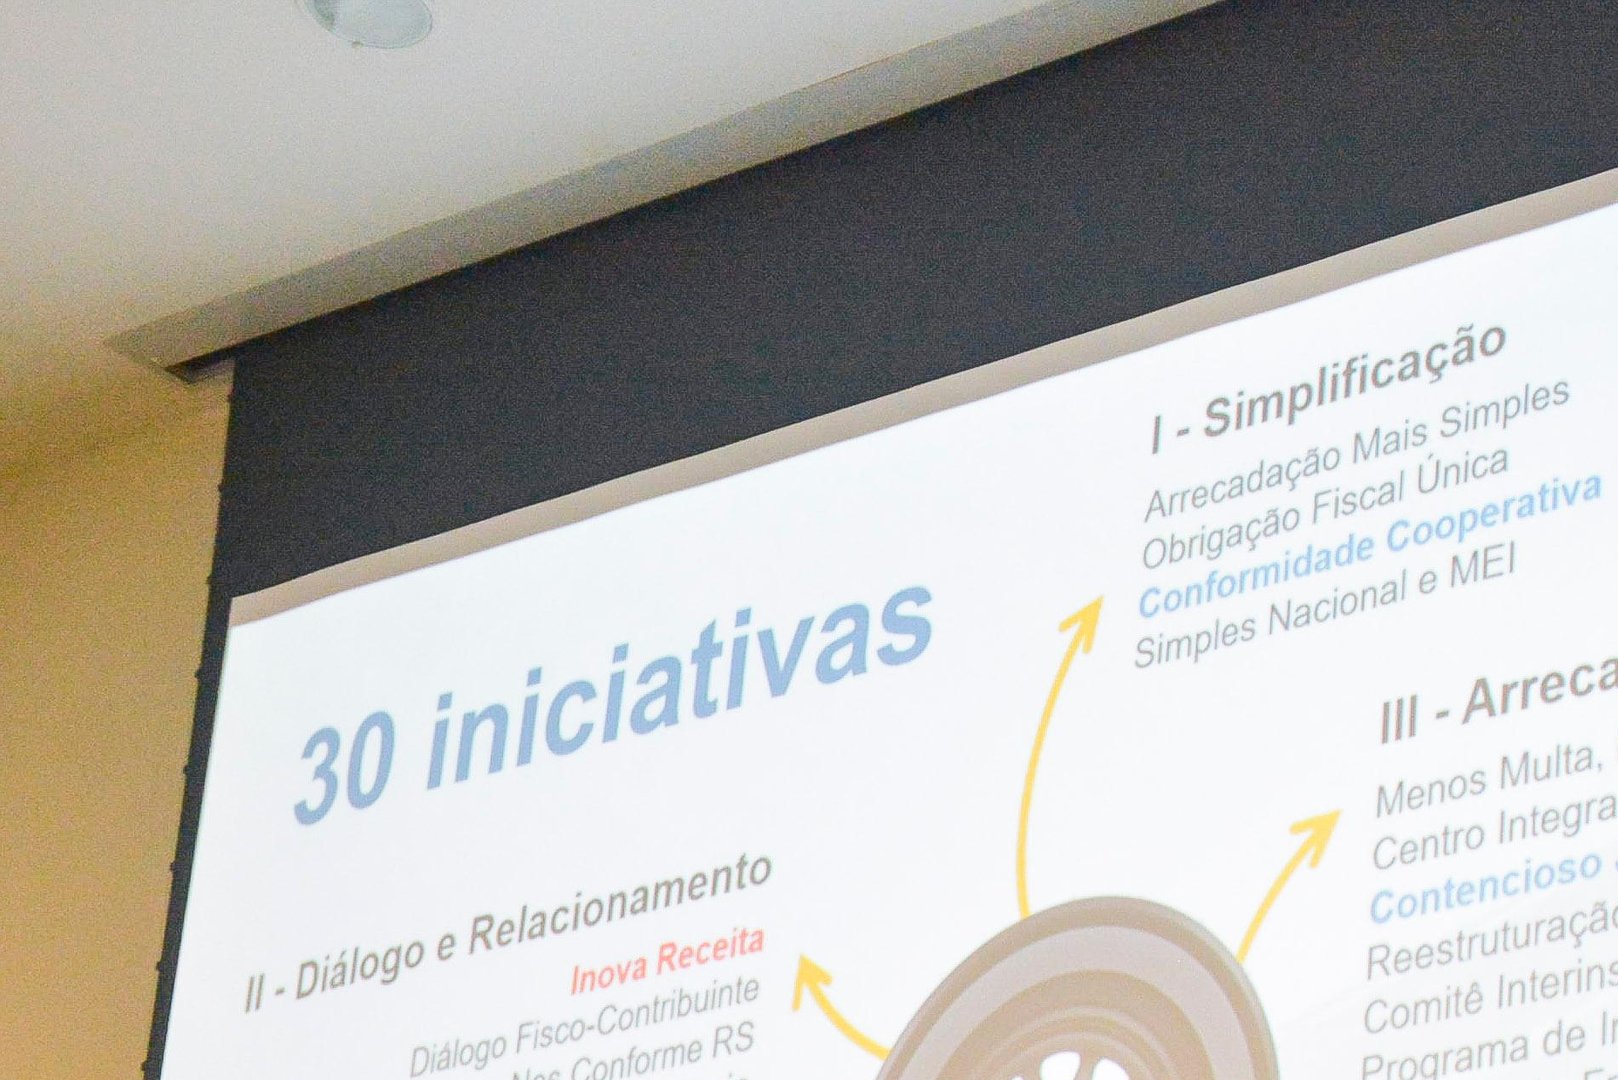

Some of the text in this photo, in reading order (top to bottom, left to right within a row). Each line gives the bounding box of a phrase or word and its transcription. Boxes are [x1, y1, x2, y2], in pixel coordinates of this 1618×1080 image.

[1152, 323, 1508, 454] I - Simplificação
[1144, 380, 1571, 523] Arrecadação Mais Simples
[1139, 474, 1603, 620] Conformidade Cooperativa
[1142, 448, 1509, 570] Obrigação Fiscal Única
[1134, 540, 1516, 669] Simples Nacional e MEI
[293, 585, 933, 826] 30 iniciativas
[1381, 694, 1418, 744] III
[1435, 709, 1450, 719] -
[1376, 769, 1488, 819] Menos
[1500, 743, 1603, 790] Multa,
[1370, 852, 1604, 925] Contencioso
[1372, 824, 1486, 870] Centro
[244, 852, 773, 1014] II - Diálogo e Relacionamento
[571, 928, 765, 995] Inova Receita
[409, 976, 760, 1079] Diálogo Fisco-Contribuinte
[712, 1020, 755, 1058] RS
[1363, 980, 1485, 1035] Comitê
[1542, 1019, 1587, 1057] de
